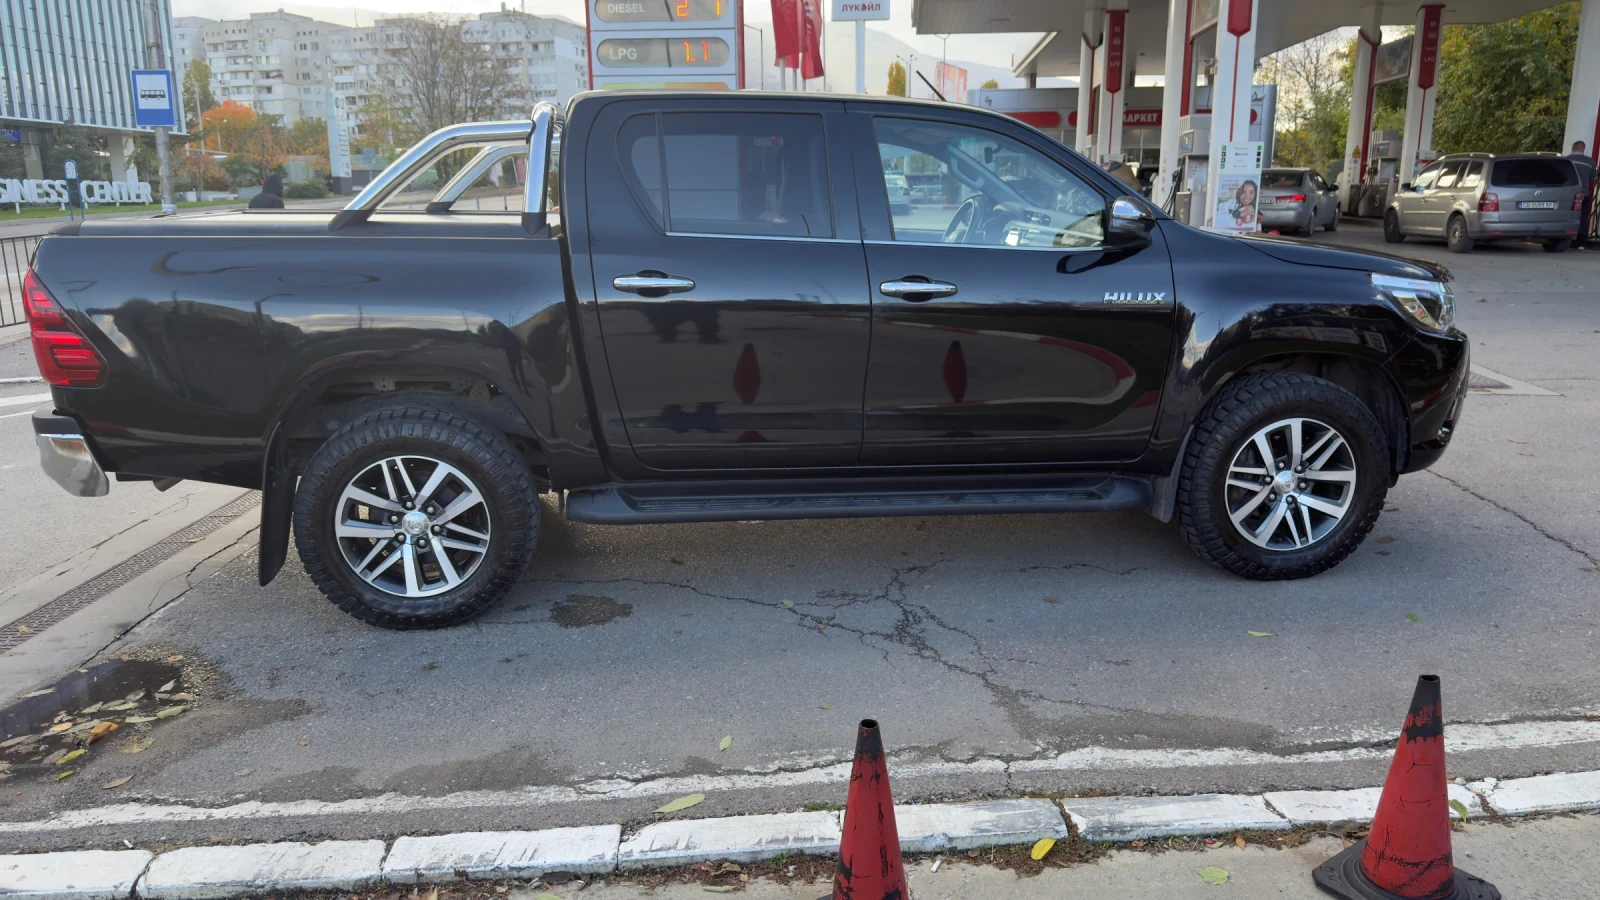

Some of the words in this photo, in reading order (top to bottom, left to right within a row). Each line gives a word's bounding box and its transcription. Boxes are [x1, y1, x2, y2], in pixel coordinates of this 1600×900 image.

[607, 2, 645, 13] DIESEL
[609, 47, 637, 60] LPG
[80, 180, 153, 203] CENTER
[1103, 292, 1166, 304] HILUX
